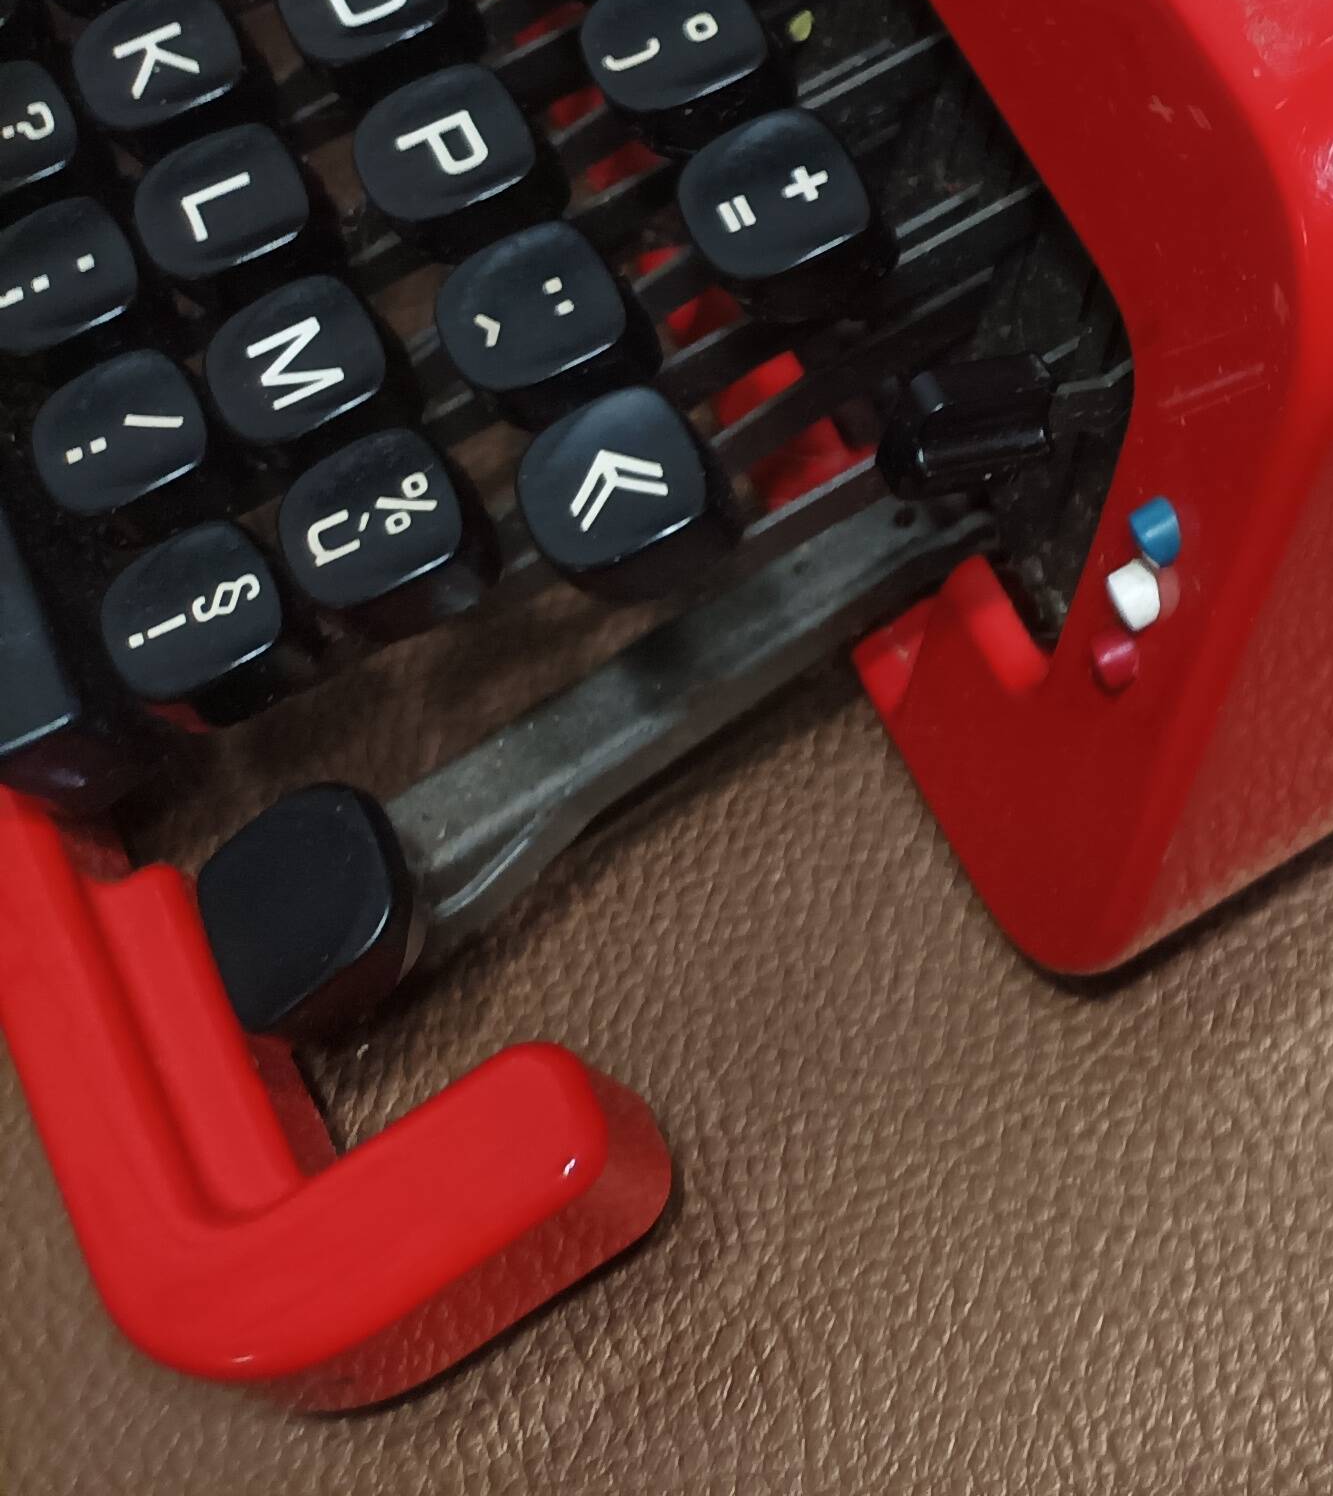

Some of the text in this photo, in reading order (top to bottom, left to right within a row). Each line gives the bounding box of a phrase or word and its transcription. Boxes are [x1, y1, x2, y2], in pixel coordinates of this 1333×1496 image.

[113, 22, 200, 100] K
[395, 109, 489, 175] P
[180, 171, 251, 242] L
[246, 315, 345, 411] M
